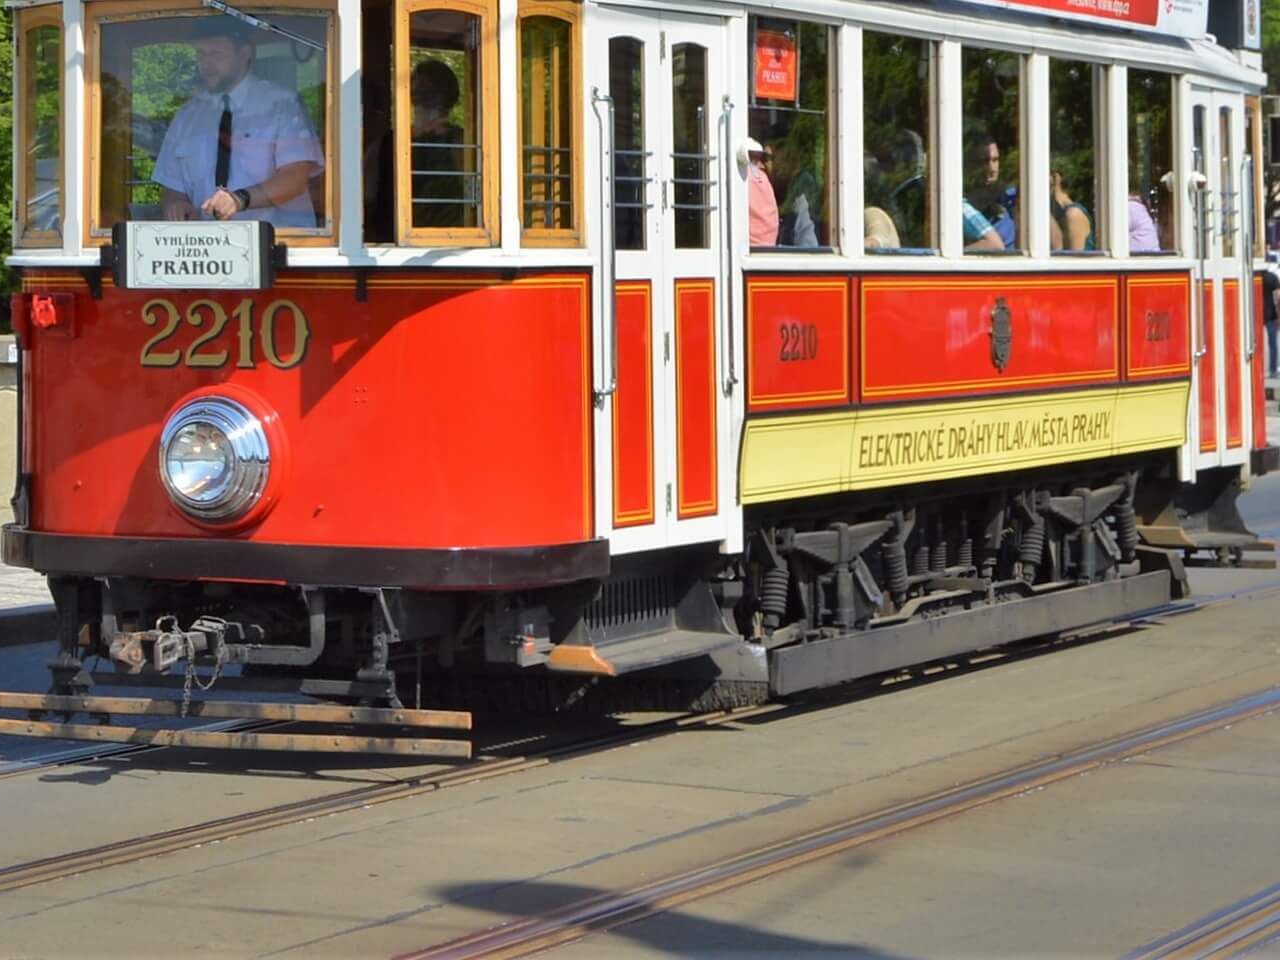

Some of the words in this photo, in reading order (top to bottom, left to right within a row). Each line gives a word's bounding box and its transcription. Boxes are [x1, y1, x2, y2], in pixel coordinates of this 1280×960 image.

[154, 233, 232, 246] VYHLÍDKOVÁ
[175, 246, 210, 258] JÍZDA
[151, 260, 233, 276] PRAHOU
[140, 298, 311, 370] 2210
[778, 322, 817, 361] 2210
[858, 421, 945, 468] ELEKTRICKÉ
[947, 420, 995, 459] DRÁHY
